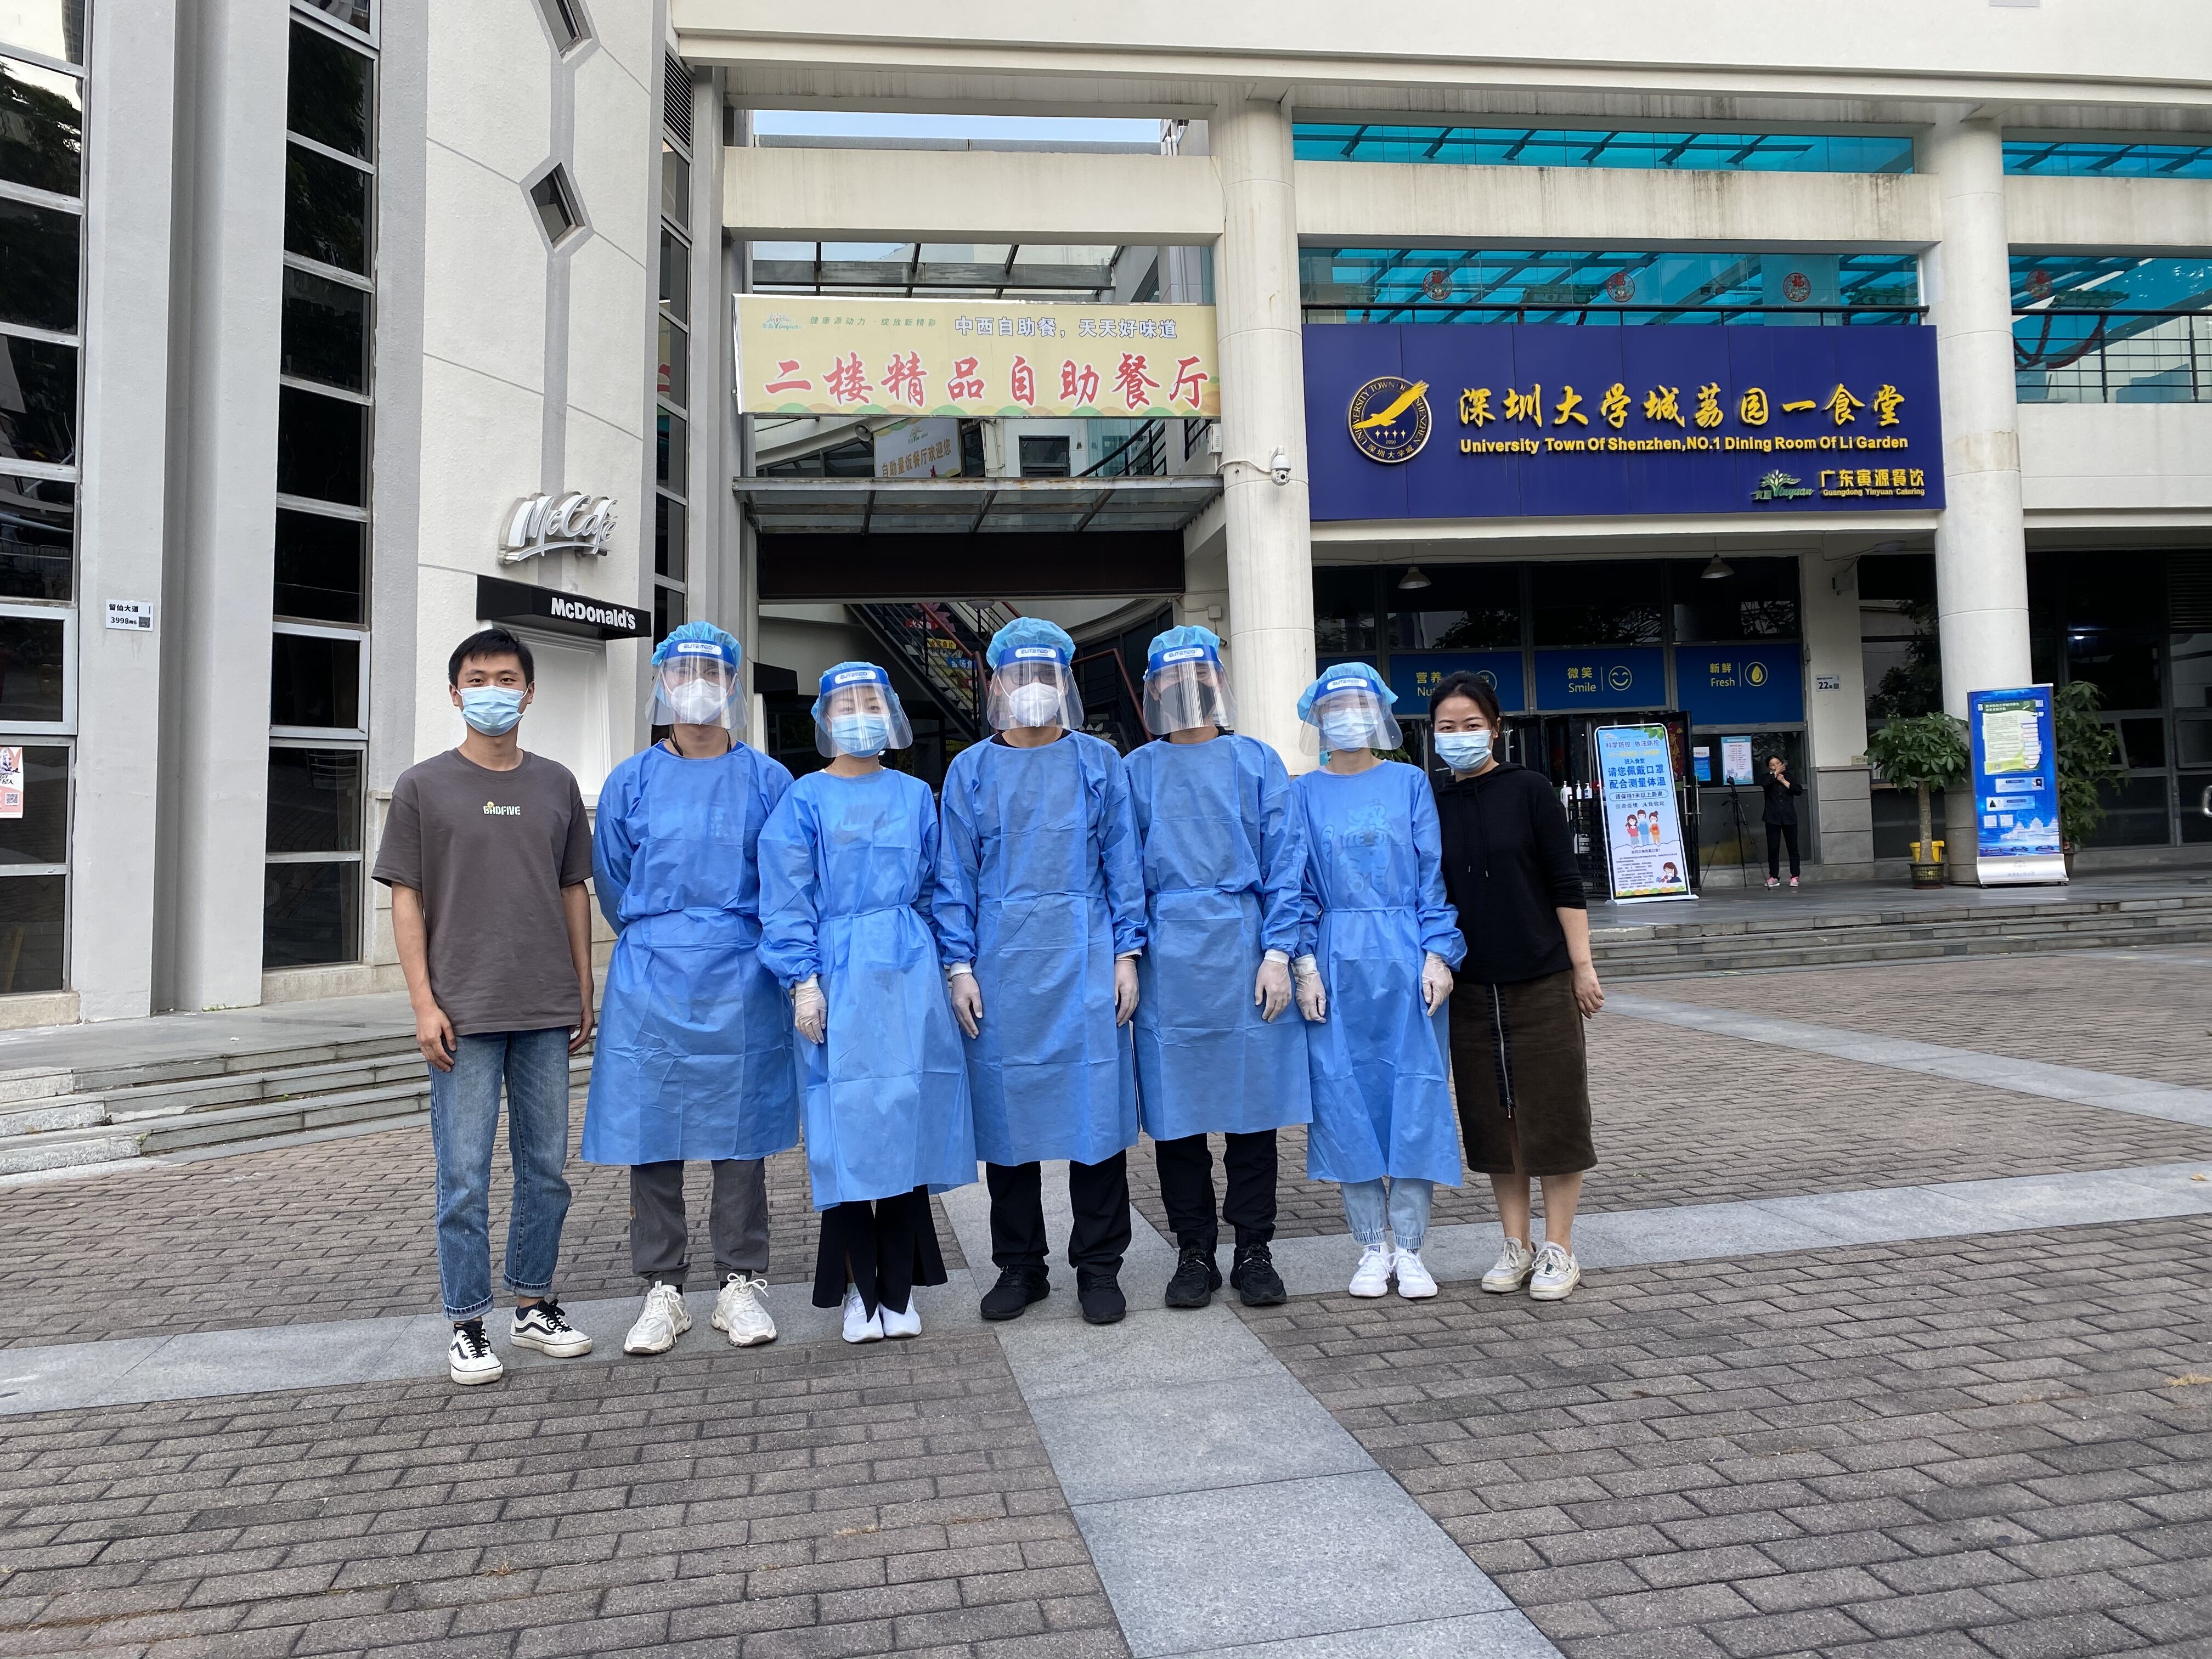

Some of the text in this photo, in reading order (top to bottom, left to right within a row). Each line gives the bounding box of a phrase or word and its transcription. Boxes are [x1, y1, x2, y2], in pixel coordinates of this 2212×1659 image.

[810, 317, 936, 327] 健康源动力 绽放新精彩
[765, 351, 1208, 410] 二楼精品自助餐厅
[1369, 381, 1395, 393] TOWN
[1459, 382, 1905, 429] 深圳大学城荔园一食堂
[1460, 438, 1539, 454] University
[1545, 438, 1585, 452] Town
[1588, 437, 1605, 450] Of
[1725, 437, 1772, 453] Dining
[1775, 437, 1816, 450] Room
[1820, 436, 1837, 449] Of
[1841, 437, 1853, 449] Li
[1857, 436, 1908, 449] Garden
[882, 438, 951, 478] 自助量饭餐厅欢迎您
[1820, 469, 1925, 488] 广东寅源餐饮
[1823, 488, 1925, 497] Guangdong Yinyuan Catering
[109, 603, 139, 613] 留仙大道
[551, 597, 636, 630] McDonald's
[1567, 667, 1593, 679] 微笑
[1710, 663, 1732, 673] 新鲜
[1416, 672, 1442, 684] 营养
[1711, 677, 1735, 687] Fresh
[1568, 682, 1596, 692] Smile
[1608, 764, 1664, 777] 请您佩戴口罩
[1609, 776, 1667, 789] 配合测量体温
[1615, 791, 1663, 800] 请保持1米以上距离
